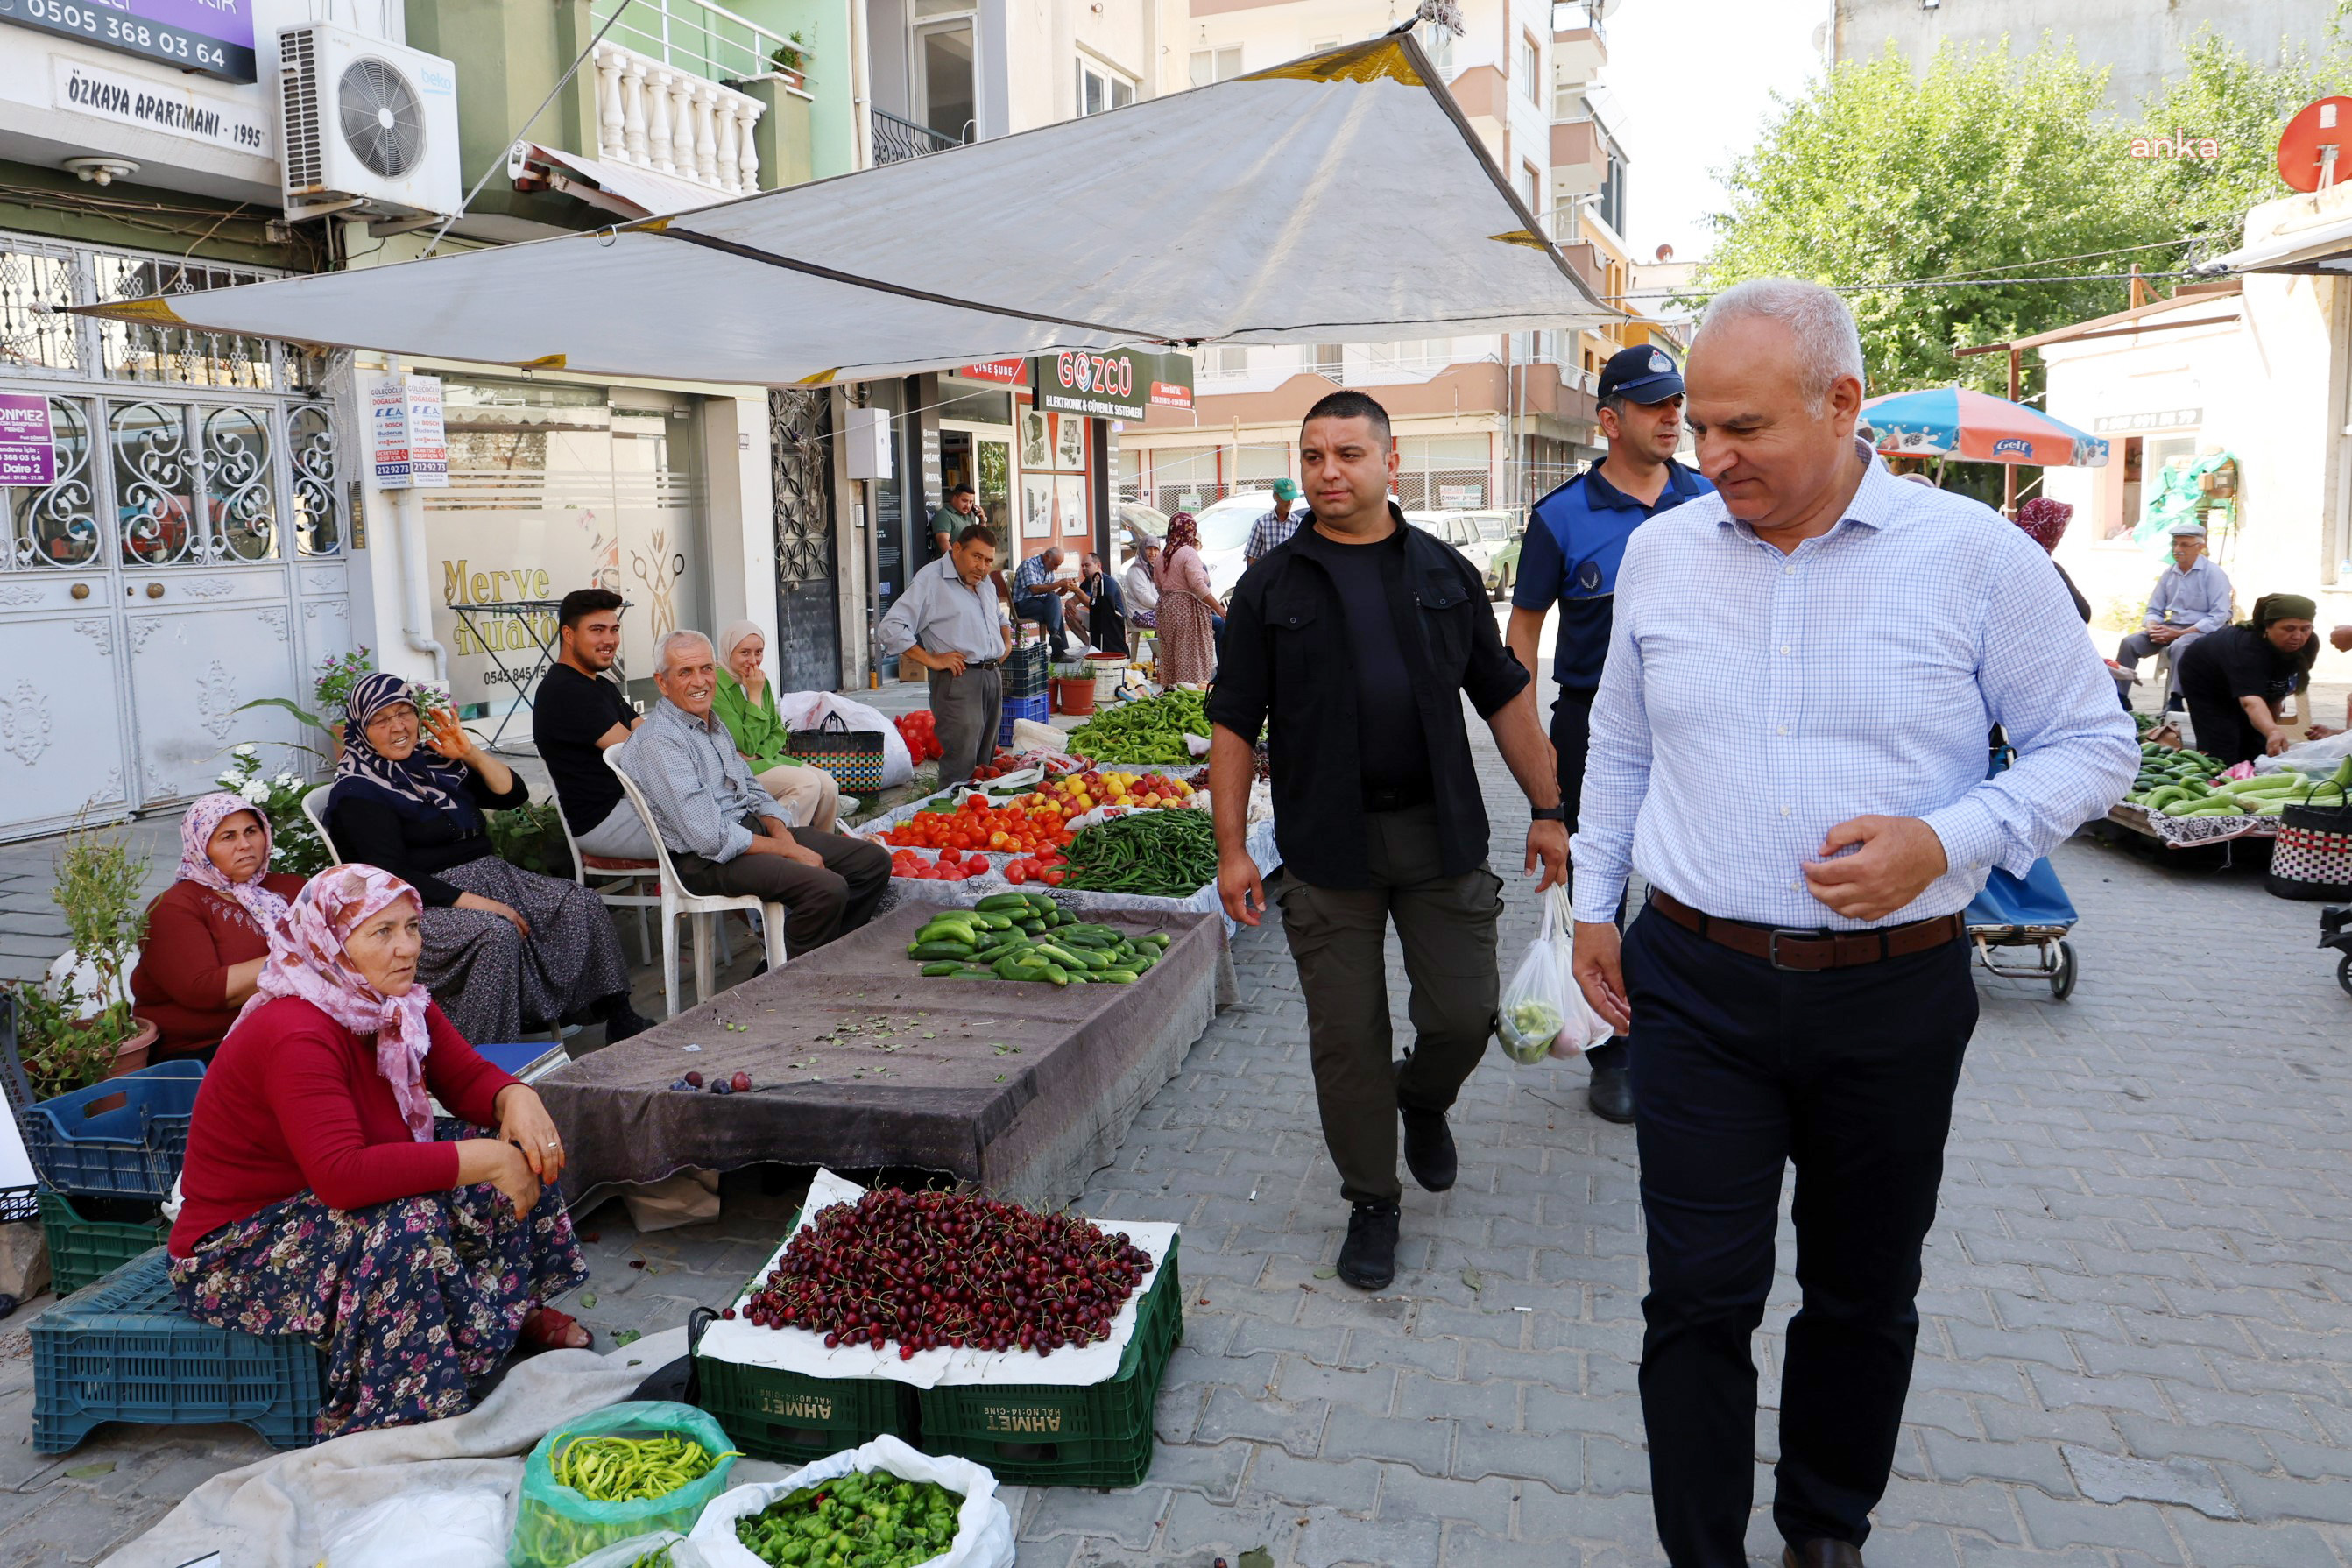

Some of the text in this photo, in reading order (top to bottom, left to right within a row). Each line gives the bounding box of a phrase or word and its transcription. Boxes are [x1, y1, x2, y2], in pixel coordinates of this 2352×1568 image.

[27, 0, 225, 67] 0505 368 03 64
[420, 67, 452, 90] beko
[69, 68, 129, 116] ÖZKAYA
[135, 93, 220, 138] APARTMANI
[233, 124, 261, 148] 1995
[994, 365, 1013, 377] ŞUBE
[372, 397, 403, 406] DOĞALGAZ
[1088, 399, 1114, 415] GÜVENLİK
[1996, 440, 2029, 451] Golf
[3, 463, 41, 474] Daire 2
[377, 464, 409, 474] 212 92 73
[413, 463, 427, 471] 212
[427, 463, 436, 471] 92
[442, 560, 550, 605] Merve
[484, 669, 510, 685] 0545
[513, 667, 532, 682] 845
[761, 1397, 832, 1420] AHMET
[1042, 1408, 1061, 1416] HAL
[986, 1416, 1061, 1432] AHMET
